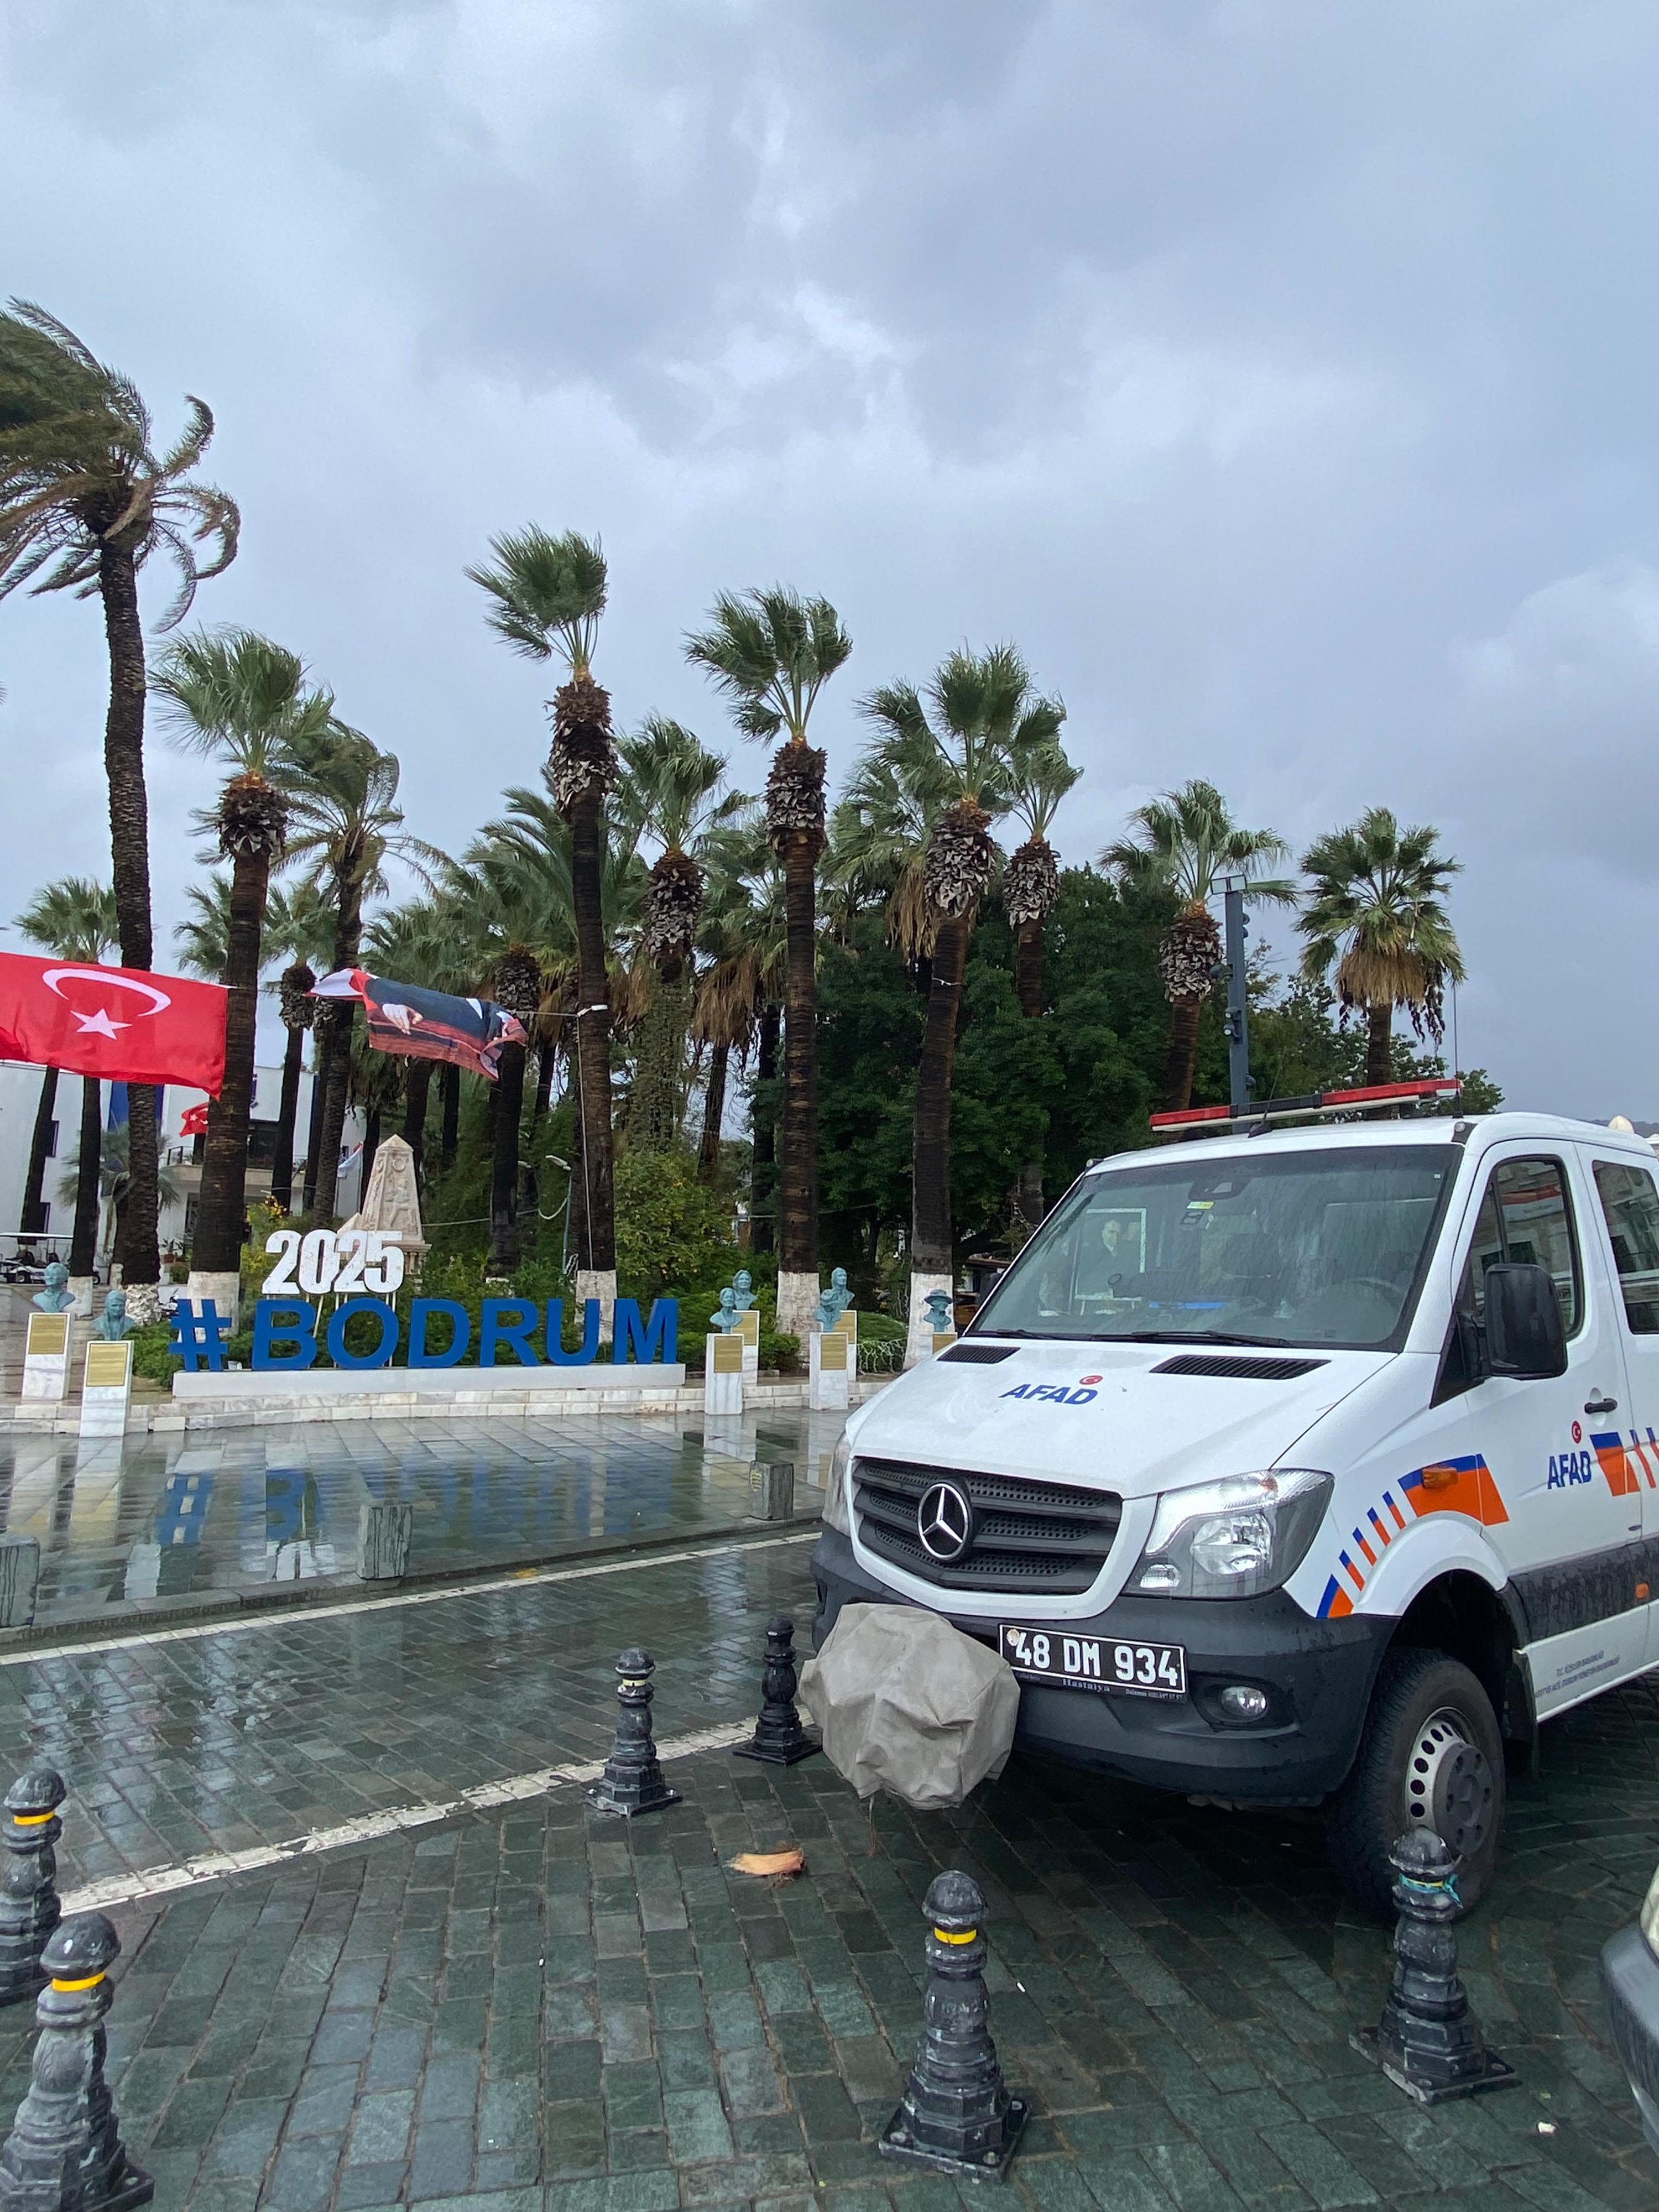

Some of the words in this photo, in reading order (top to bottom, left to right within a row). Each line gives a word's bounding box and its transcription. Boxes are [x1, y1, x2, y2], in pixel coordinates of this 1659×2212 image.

[262, 1229, 404, 1294] 2025
[168, 1297, 679, 1371] #BODRUM
[998, 1384, 1098, 1405] AFAD
[1547, 1451, 1592, 1489] AFAD
[1015, 1632, 1050, 1669] 48
[1063, 1638, 1100, 1677] DM
[1114, 1645, 1178, 1687] 934
